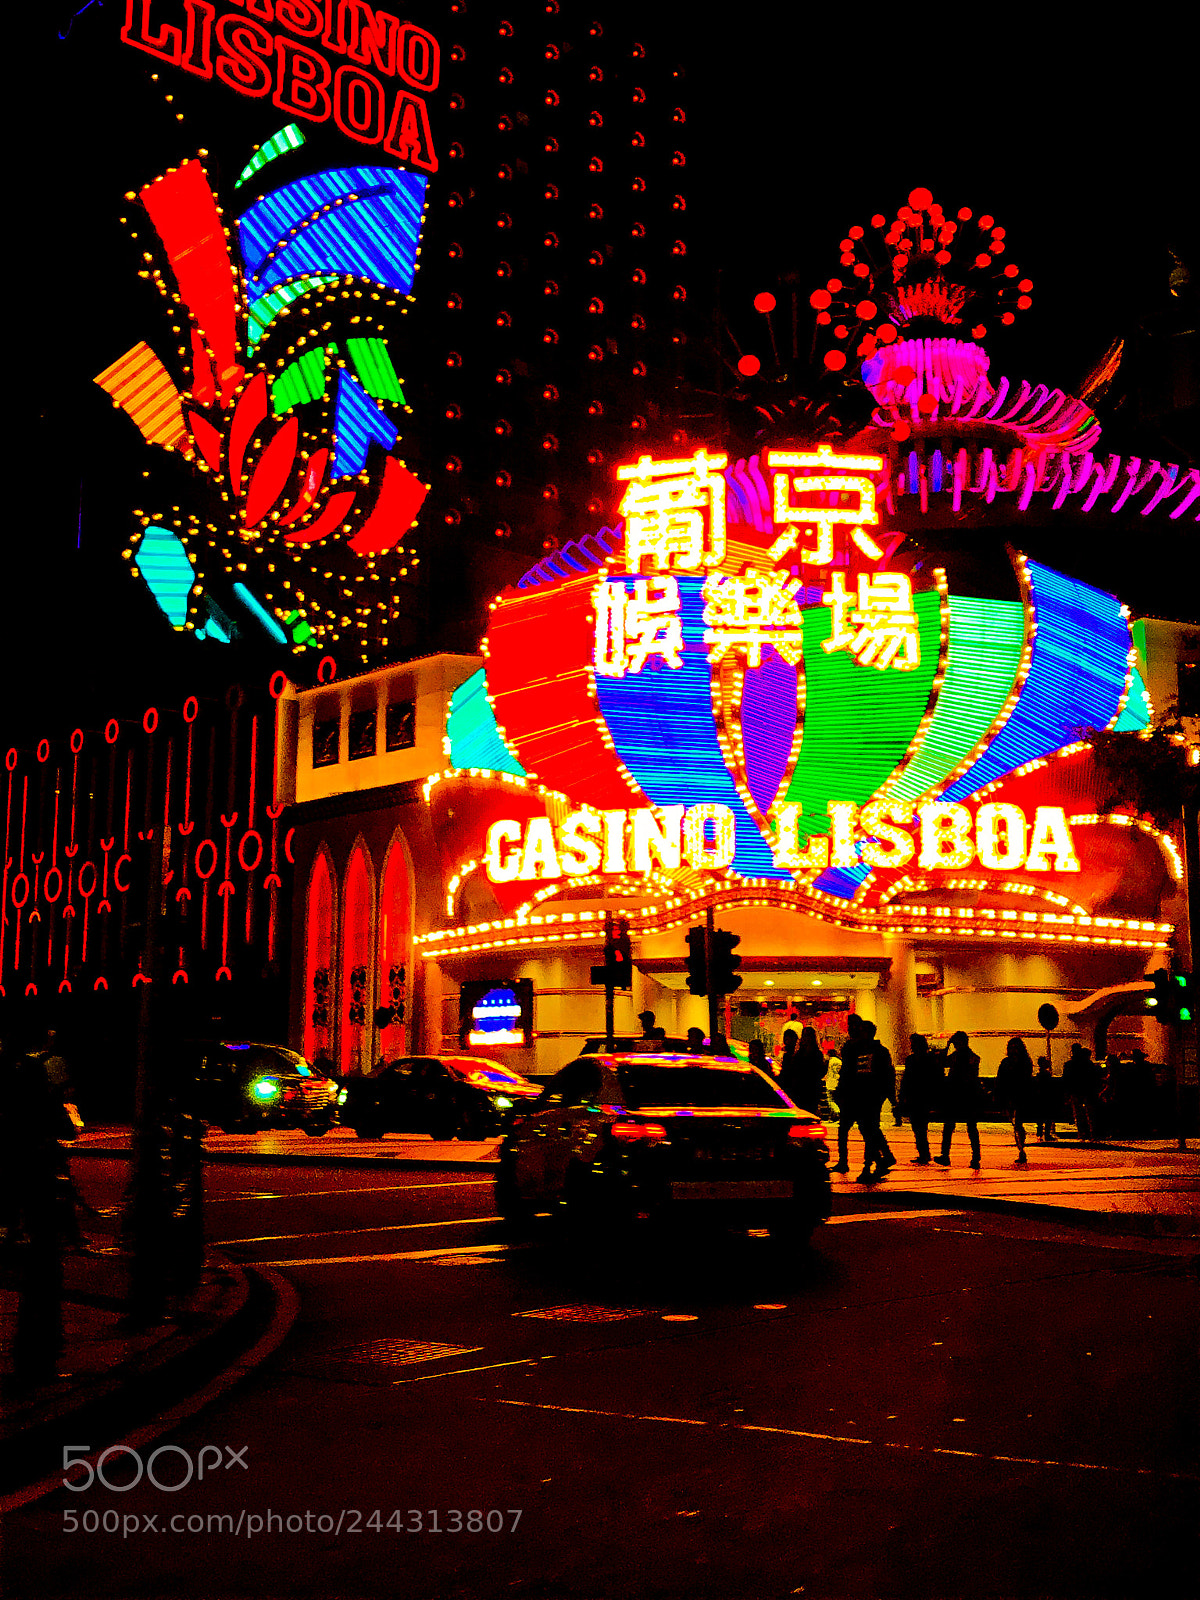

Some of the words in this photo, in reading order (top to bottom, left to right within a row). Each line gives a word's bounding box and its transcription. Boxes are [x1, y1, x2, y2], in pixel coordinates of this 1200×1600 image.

[121, 0, 438, 172] LISBOA
[617, 445, 883, 573] 葡京
[484, 801, 735, 884] CASINO
[773, 799, 1081, 873] LISBOA
